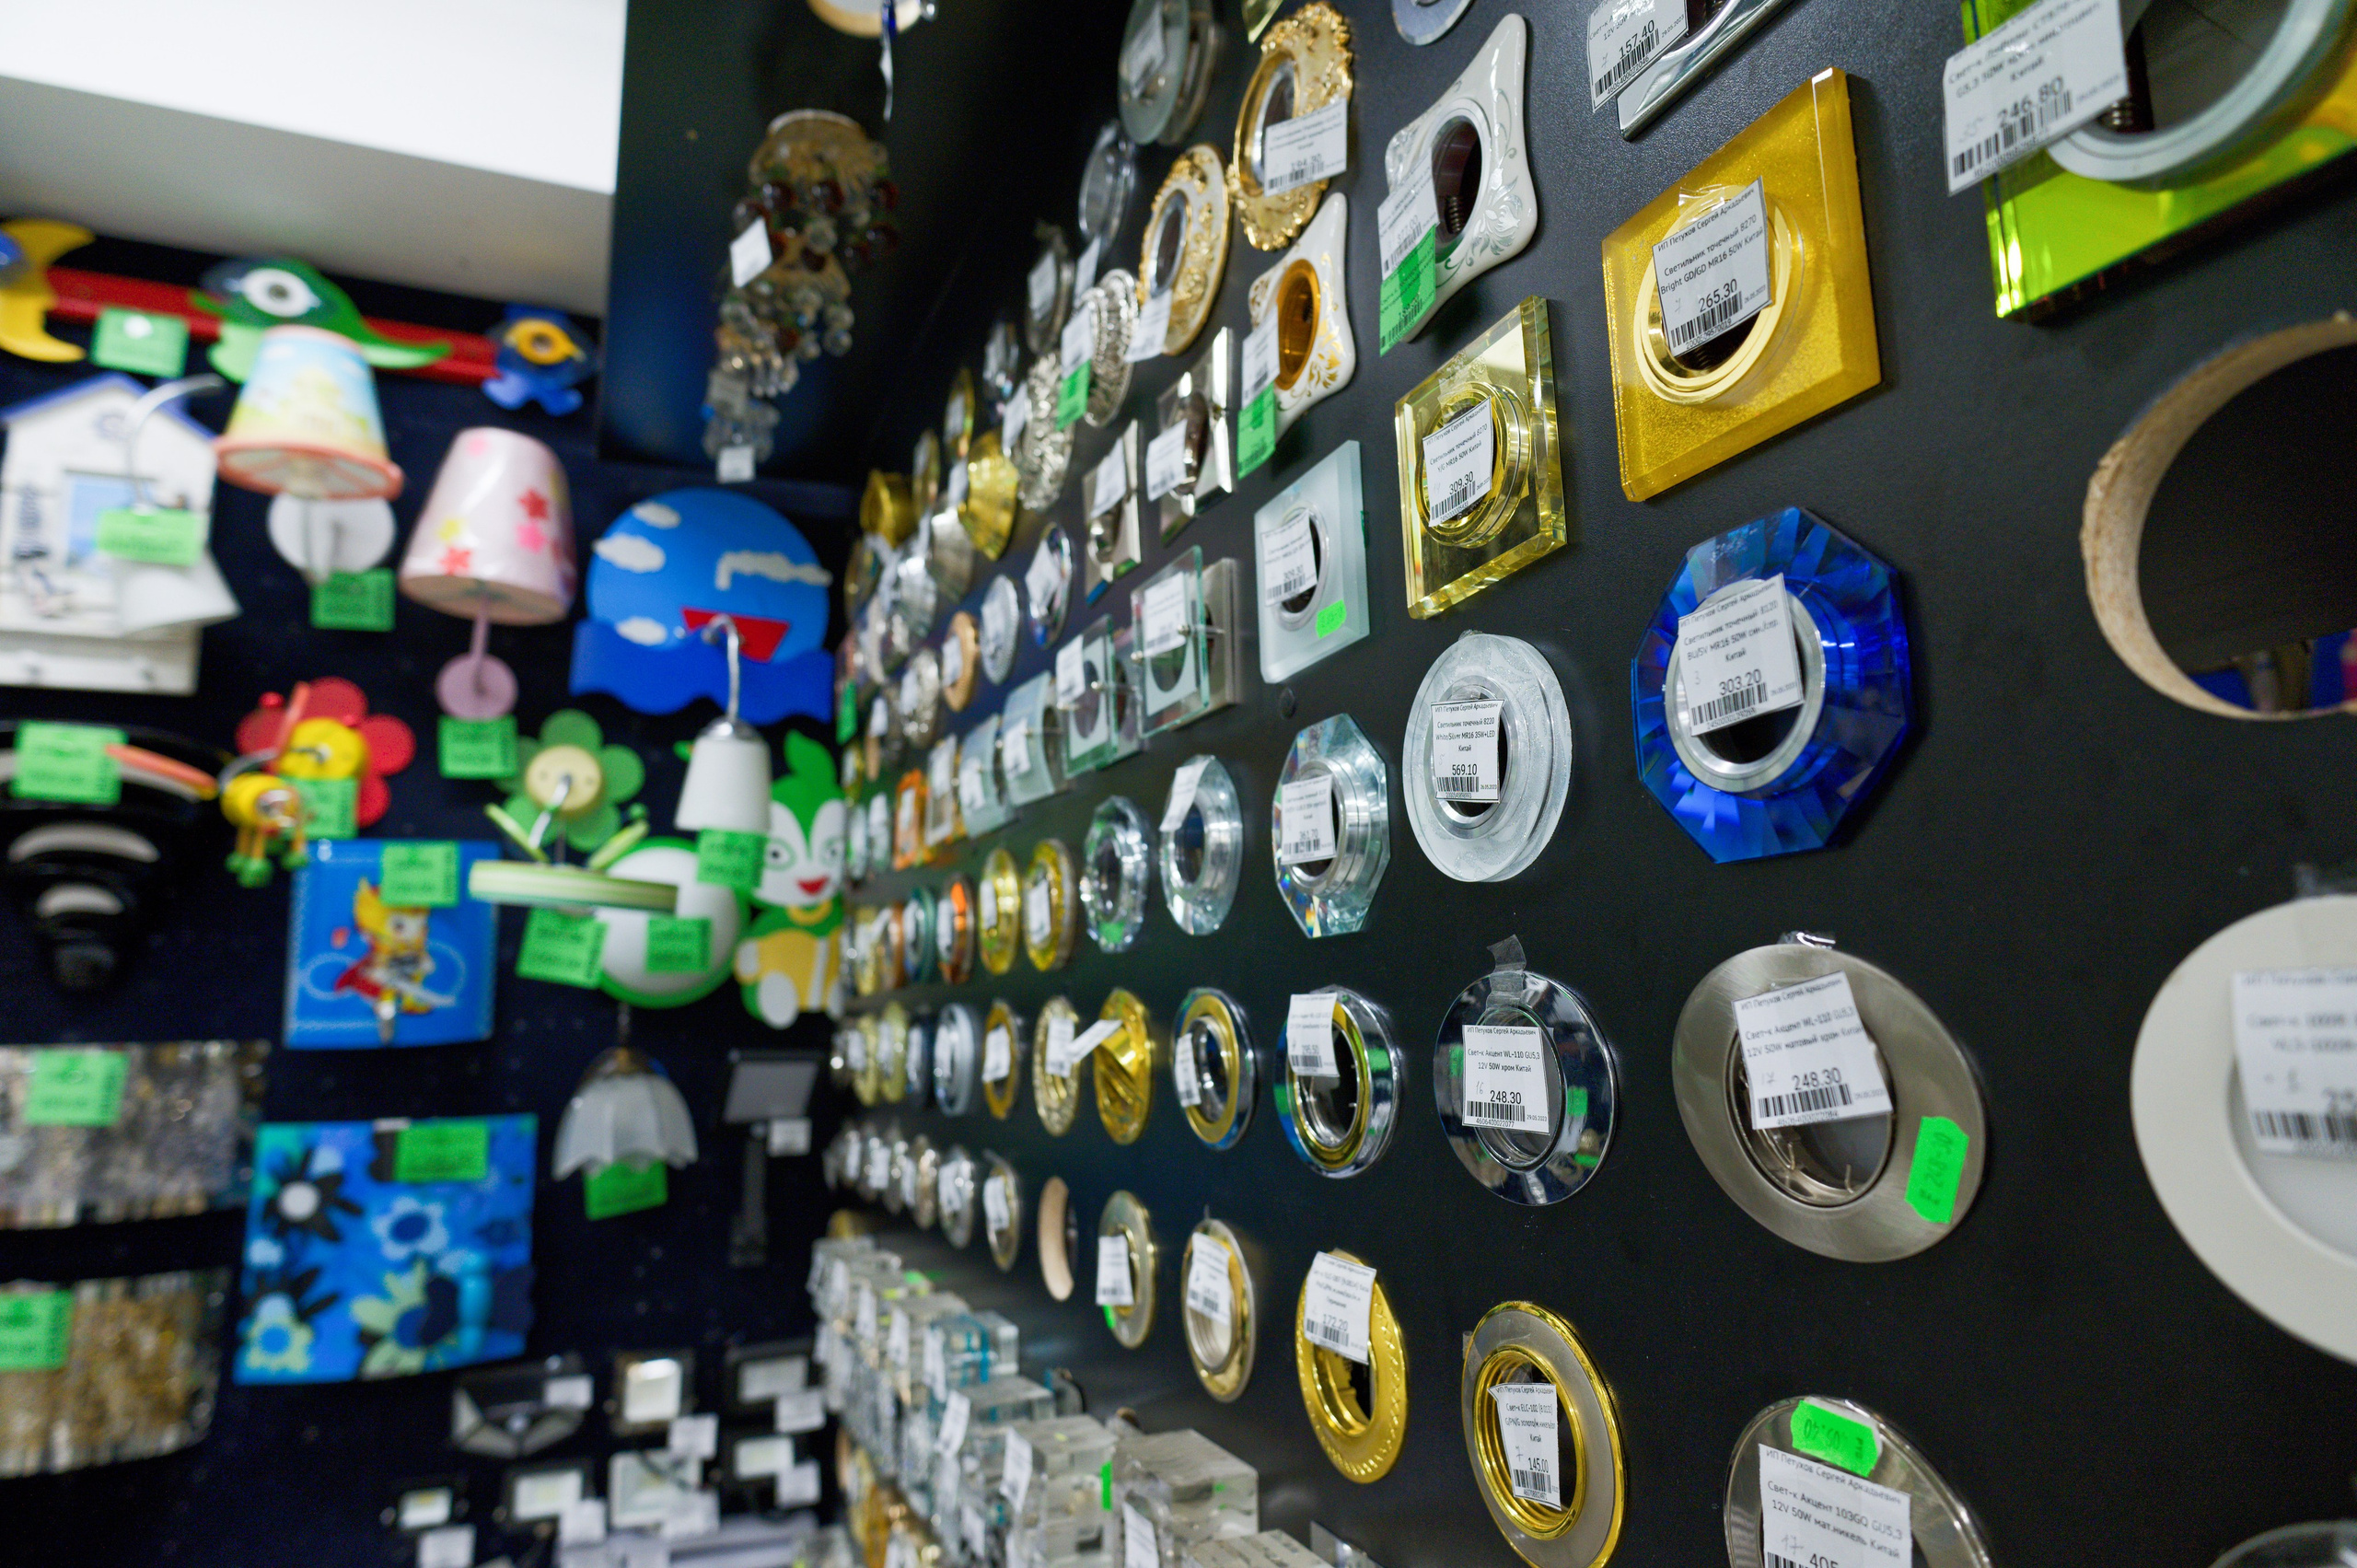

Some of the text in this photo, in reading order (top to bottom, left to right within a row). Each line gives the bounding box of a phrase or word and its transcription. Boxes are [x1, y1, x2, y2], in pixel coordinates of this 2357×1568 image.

[1619, 19, 1655, 59] 157.40
[1998, 74, 2064, 128] 246.80
[1657, 188, 1754, 252] ИП Петухов Сергей Аркадьевич
[1664, 214, 1757, 276] Светильник точечный 8270
[1660, 227, 1763, 295] Bright GD/GD MR16 50W Китай
[1698, 278, 1737, 312] 265.30
[1449, 470, 1473, 495] 309.30
[1719, 668, 1762, 695] 303.20
[1444, 705, 1459, 714] Петухов
[1460, 703, 1473, 713] Сергей
[1473, 703, 1498, 711] Аркадьевич
[1462, 718, 1483, 726] точечный
[1483, 717, 1495, 726] 8220
[1462, 731, 1474, 739] MR16
[1452, 763, 1478, 775] 569.10
[1474, 1027, 1492, 1035] Петухов
[1493, 1028, 1509, 1036] Сергей
[1510, 1028, 1536, 1036] Аркадьевич
[1478, 1062, 1488, 1070] 12V
[1485, 1050, 1503, 1058] Акцент
[1504, 1051, 1524, 1059] WL-110
[1792, 1066, 1841, 1091] 248.30
[1490, 1090, 1522, 1104] 248.30
[1521, 1387, 1535, 1395] Сергей
[1530, 1434, 1542, 1443] Китай
[1528, 1457, 1550, 1473] 145.00
[1766, 1449, 1901, 1504] ИП Петухов Сергей Аркадьевич
[1767, 1481, 1798, 1499] Свет-к
[1800, 1493, 1833, 1513] Акцент
[1772, 1499, 1900, 1558] 12V 50W мат.никель Китай
